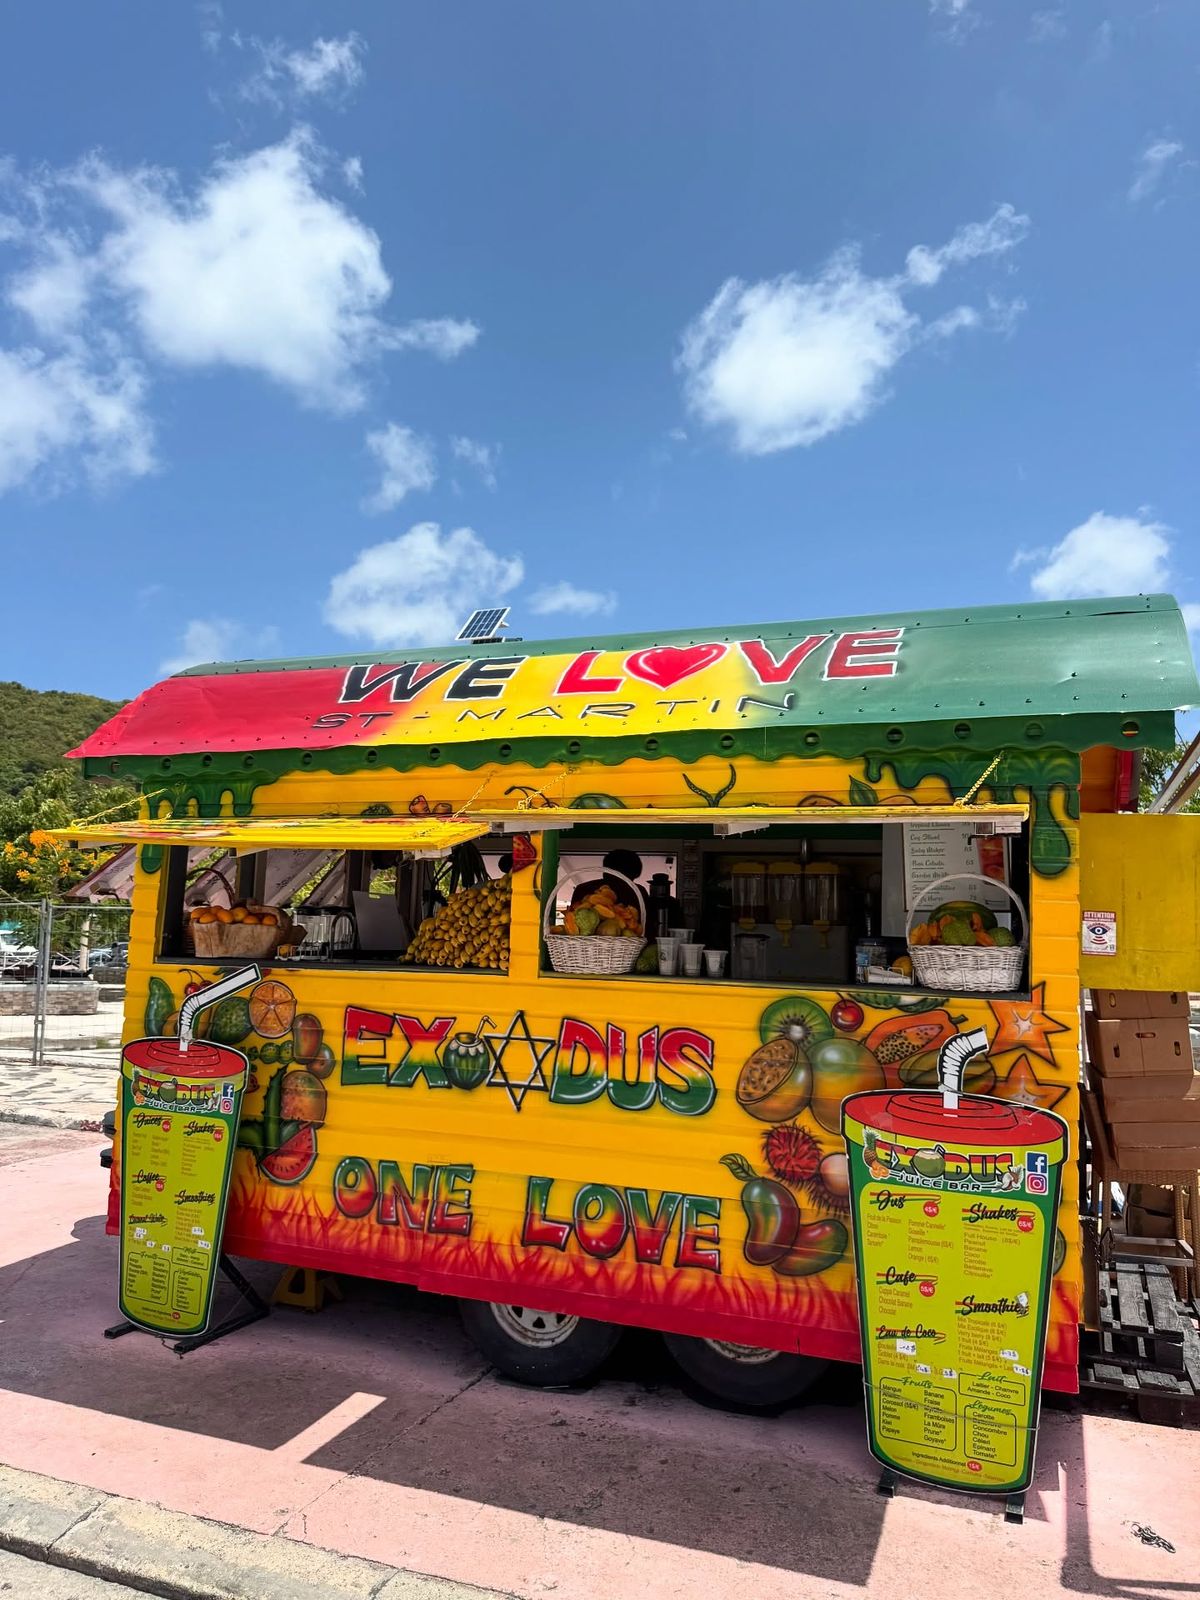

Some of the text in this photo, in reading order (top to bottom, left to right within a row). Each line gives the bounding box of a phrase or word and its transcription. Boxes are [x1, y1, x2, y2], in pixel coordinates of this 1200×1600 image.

[338, 656, 528, 703] WE
[150, 1100, 197, 1113] JUICE BAR
[186, 1120, 216, 1137] Shakes
[136, 1169, 160, 1184] Coffee
[898, 1173, 982, 1192] JUICE BAR
[177, 1189, 216, 1205] Smoothies
[876, 1190, 906, 1211] Jus
[333, 1156, 721, 1274] ONE LOVE
[969, 1202, 1018, 1223] Shakes
[879, 1324, 937, 1339] Eau de Coco
[882, 1384, 902, 1393] Mangue
[900, 1376, 934, 1389] Fruits
[924, 1389, 944, 1399] Banane
[967, 1387, 991, 1396] Amande
[995, 1391, 1011, 1399] Coco
[995, 1385, 1019, 1394] Chanvre
[924, 1398, 941, 1406] Fraise
[882, 1412, 901, 1420] Pomme
[973, 1411, 995, 1420] Carotte
[973, 1424, 1008, 1436] Concombre
[973, 1430, 989, 1439] Chou
